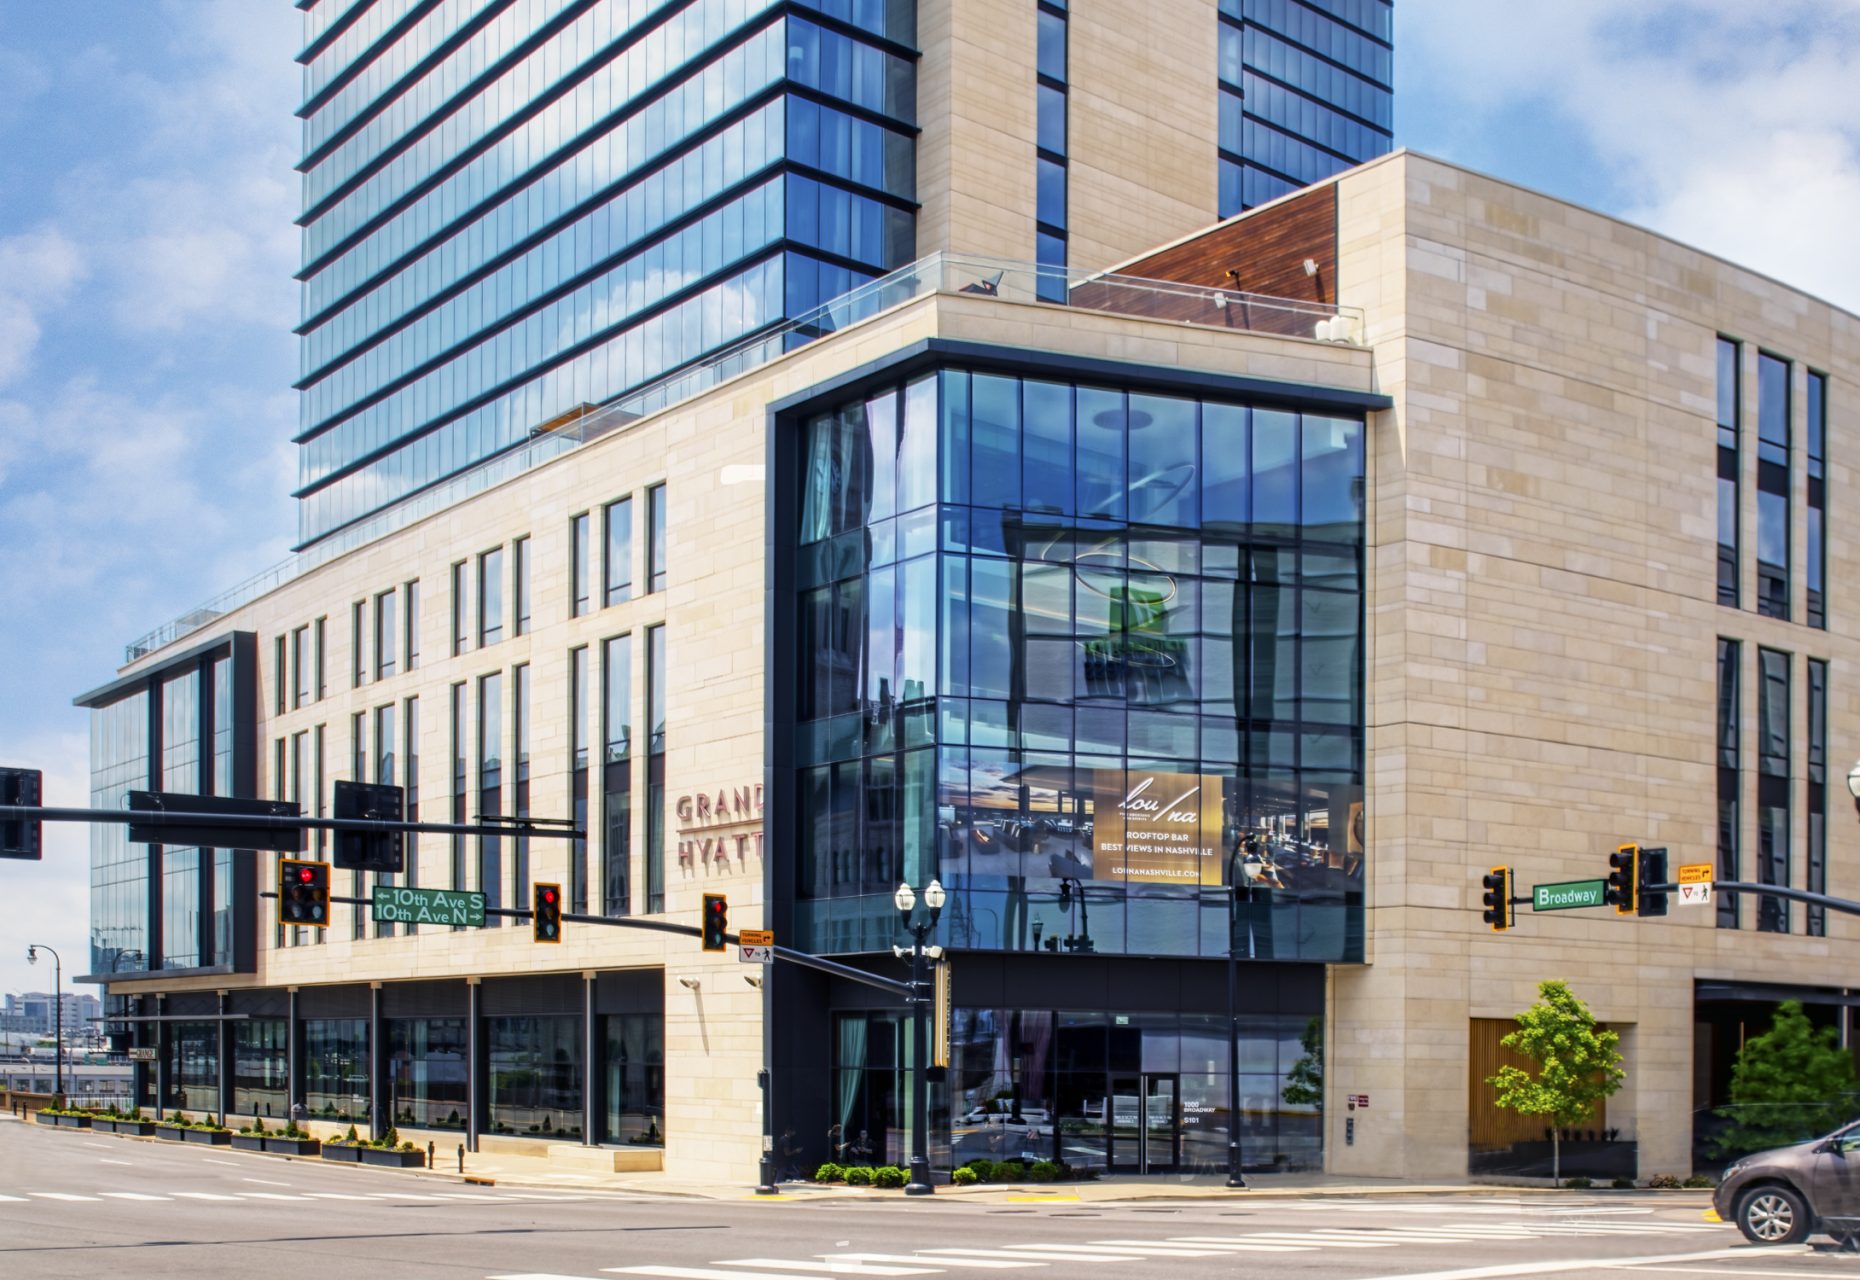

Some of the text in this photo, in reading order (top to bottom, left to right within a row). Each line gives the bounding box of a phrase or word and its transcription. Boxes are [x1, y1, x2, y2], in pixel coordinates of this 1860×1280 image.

[1126, 831, 1170, 841] ROOFTOP
[678, 832, 764, 867] HYATT
[1101, 842, 1123, 851] BEST
[1154, 846, 1163, 854] IN
[392, 889, 484, 910] 10th Ave S
[1539, 888, 1597, 906] Broadway
[376, 903, 467, 924] 10th Ave N
